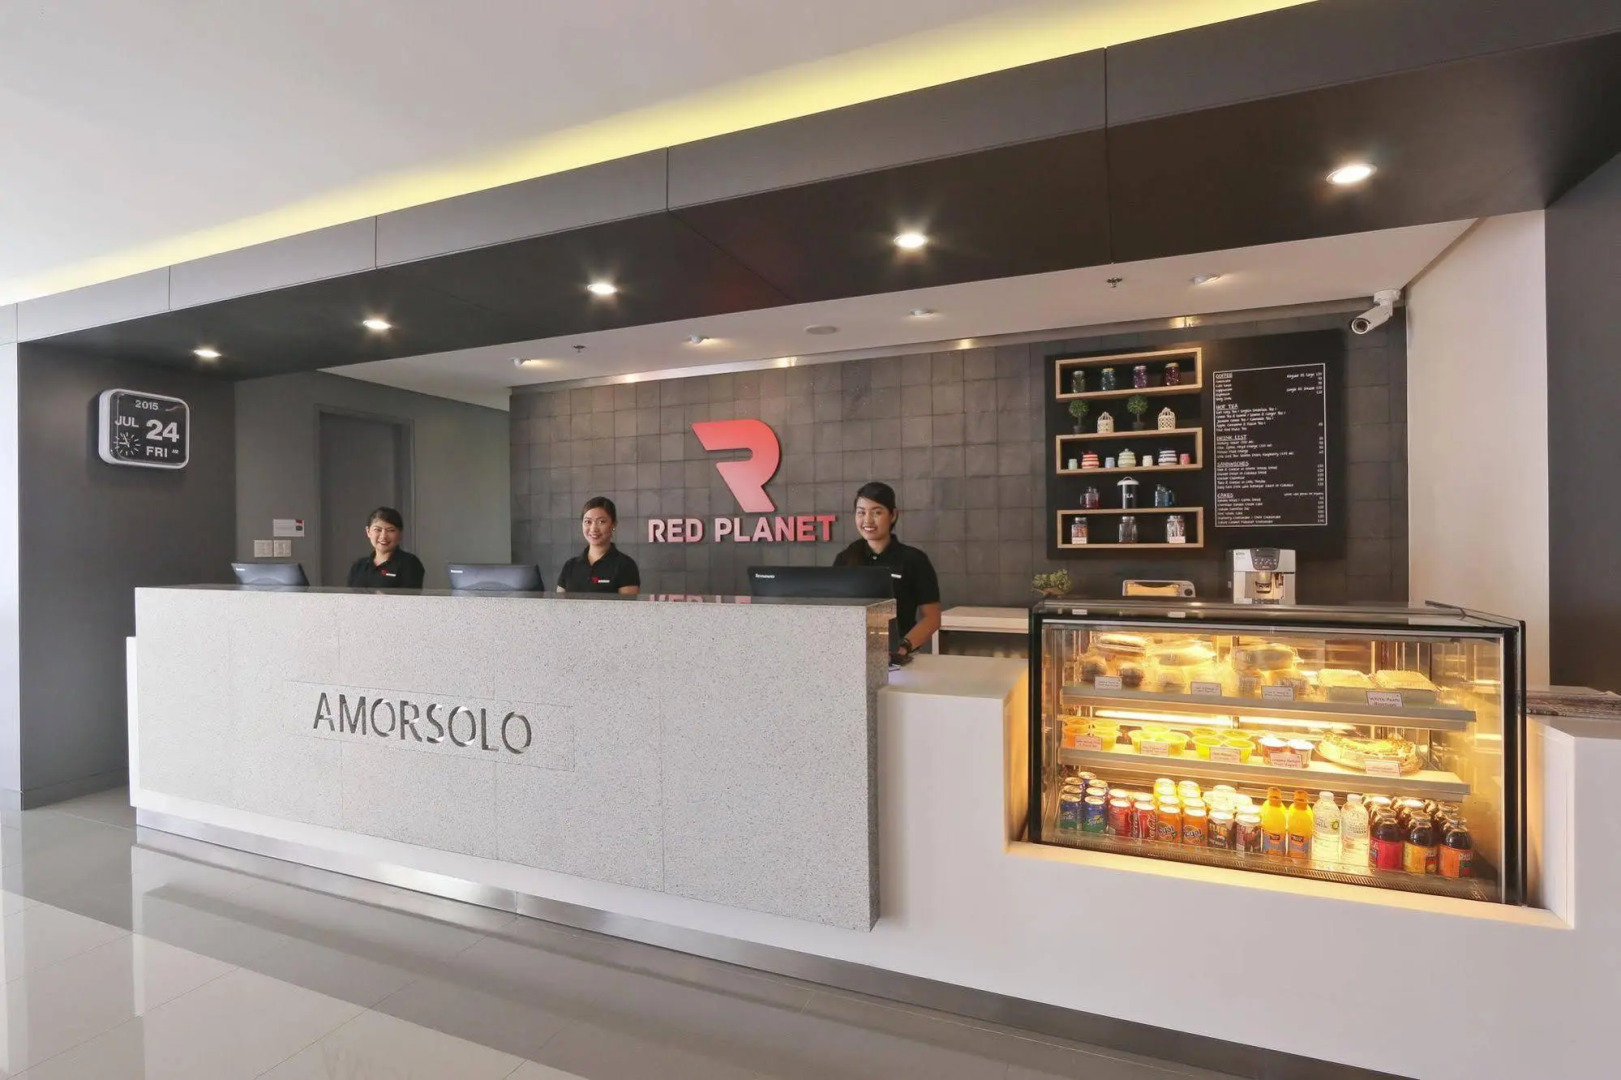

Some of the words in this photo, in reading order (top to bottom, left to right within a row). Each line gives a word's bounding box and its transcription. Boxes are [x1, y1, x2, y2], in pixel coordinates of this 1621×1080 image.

[135, 400, 159, 411] 2015
[115, 416, 139, 428] JUL
[146, 419, 179, 443] 24
[146, 446, 168, 458] FRI
[648, 517, 704, 543] RED
[714, 514, 837, 543] PLANET
[313, 692, 533, 755] AMORSOLO
